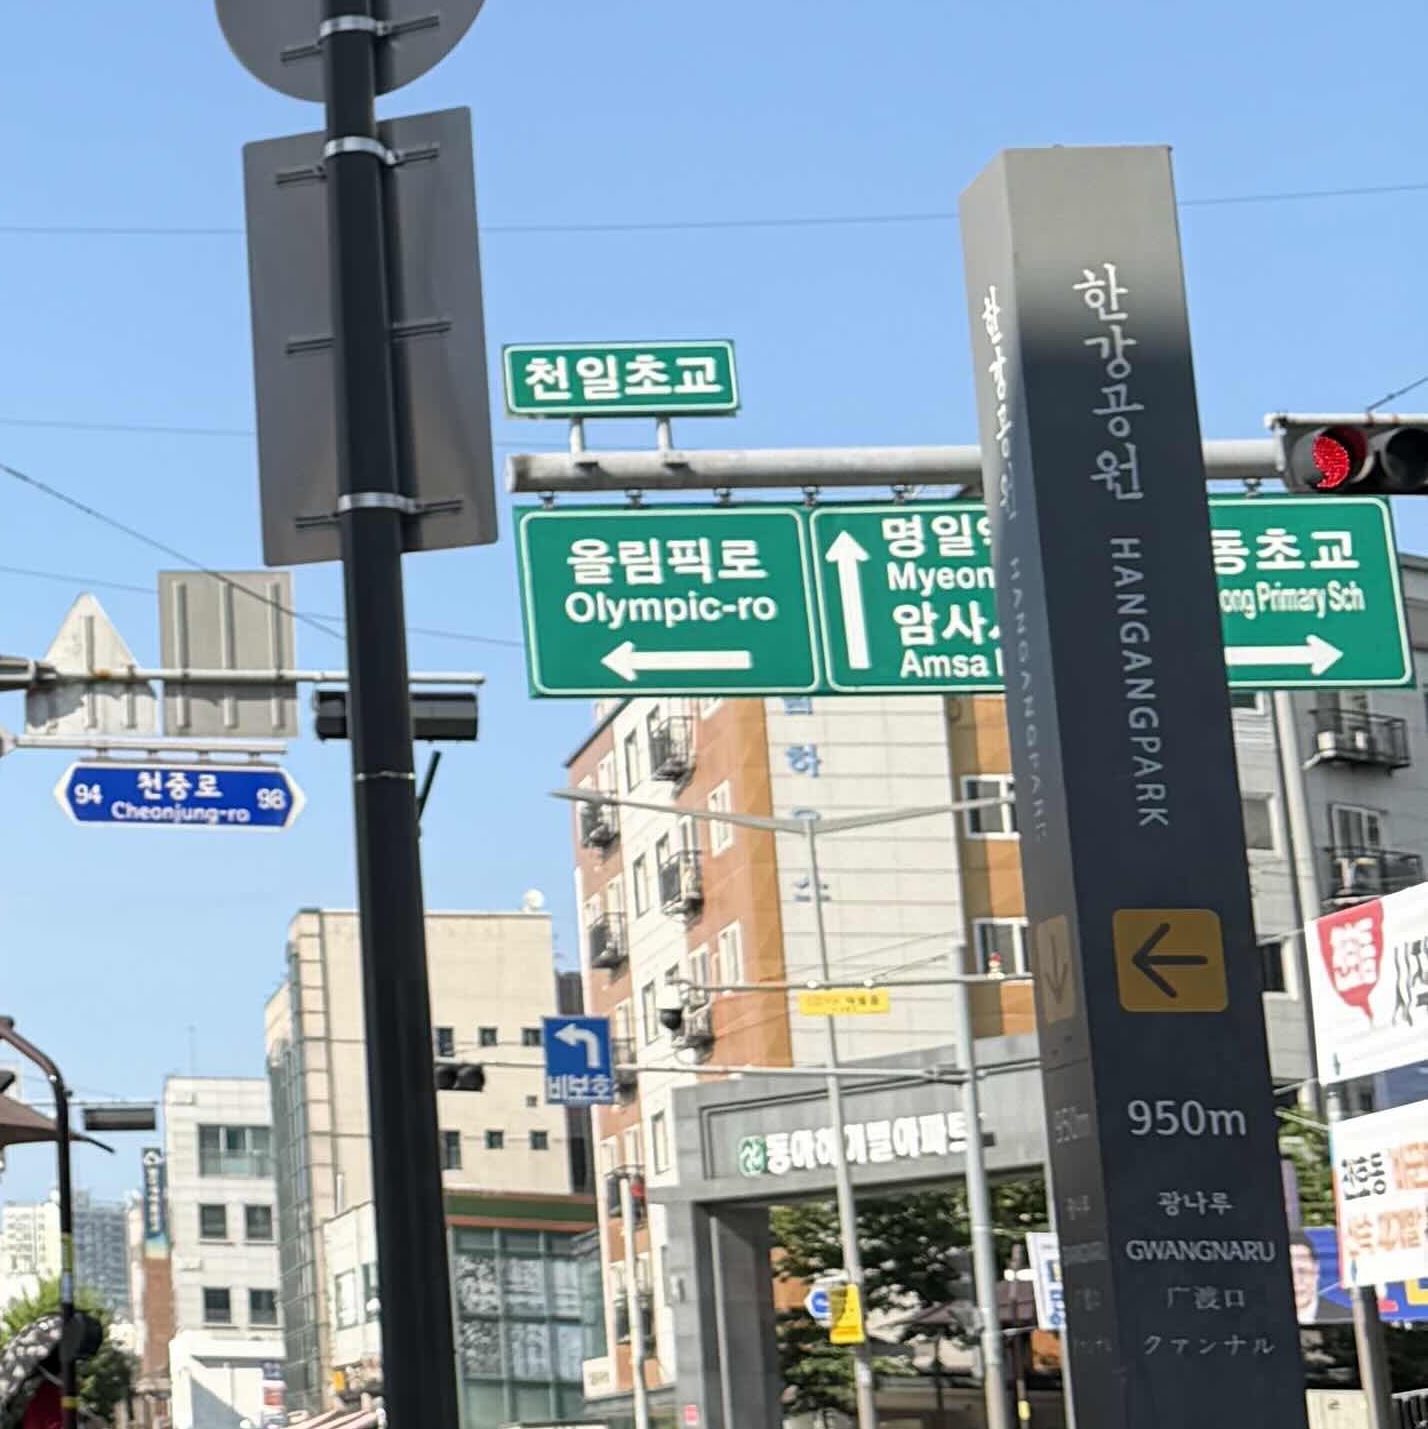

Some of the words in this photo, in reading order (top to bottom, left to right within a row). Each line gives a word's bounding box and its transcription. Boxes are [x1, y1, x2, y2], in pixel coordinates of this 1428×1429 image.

[525, 354, 724, 401] 천일초교
[1072, 262, 1144, 501] 한강공원
[566, 537, 768, 586] 올림픽로
[1210, 528, 1360, 575] 동초교
[887, 561, 995, 597] Myeon
[564, 590, 777, 630] Olympic-ro
[1256, 581, 1326, 618] Primary
[1327, 580, 1365, 612] Sch
[892, 600, 1001, 646] 암사
[900, 649, 989, 678] Amsa
[1110, 537, 1169, 827] HANGANGPARK
[74, 784, 103, 804] 94
[137, 771, 223, 800] 천중로
[111, 801, 250, 823] Cheonjung-ro
[547, 1074, 611, 1100] 비보호
[1127, 1099, 1247, 1136] 950m
[1158, 1191, 1233, 1217] 광나루
[1126, 1239, 1275, 1262] GWANGNARU
